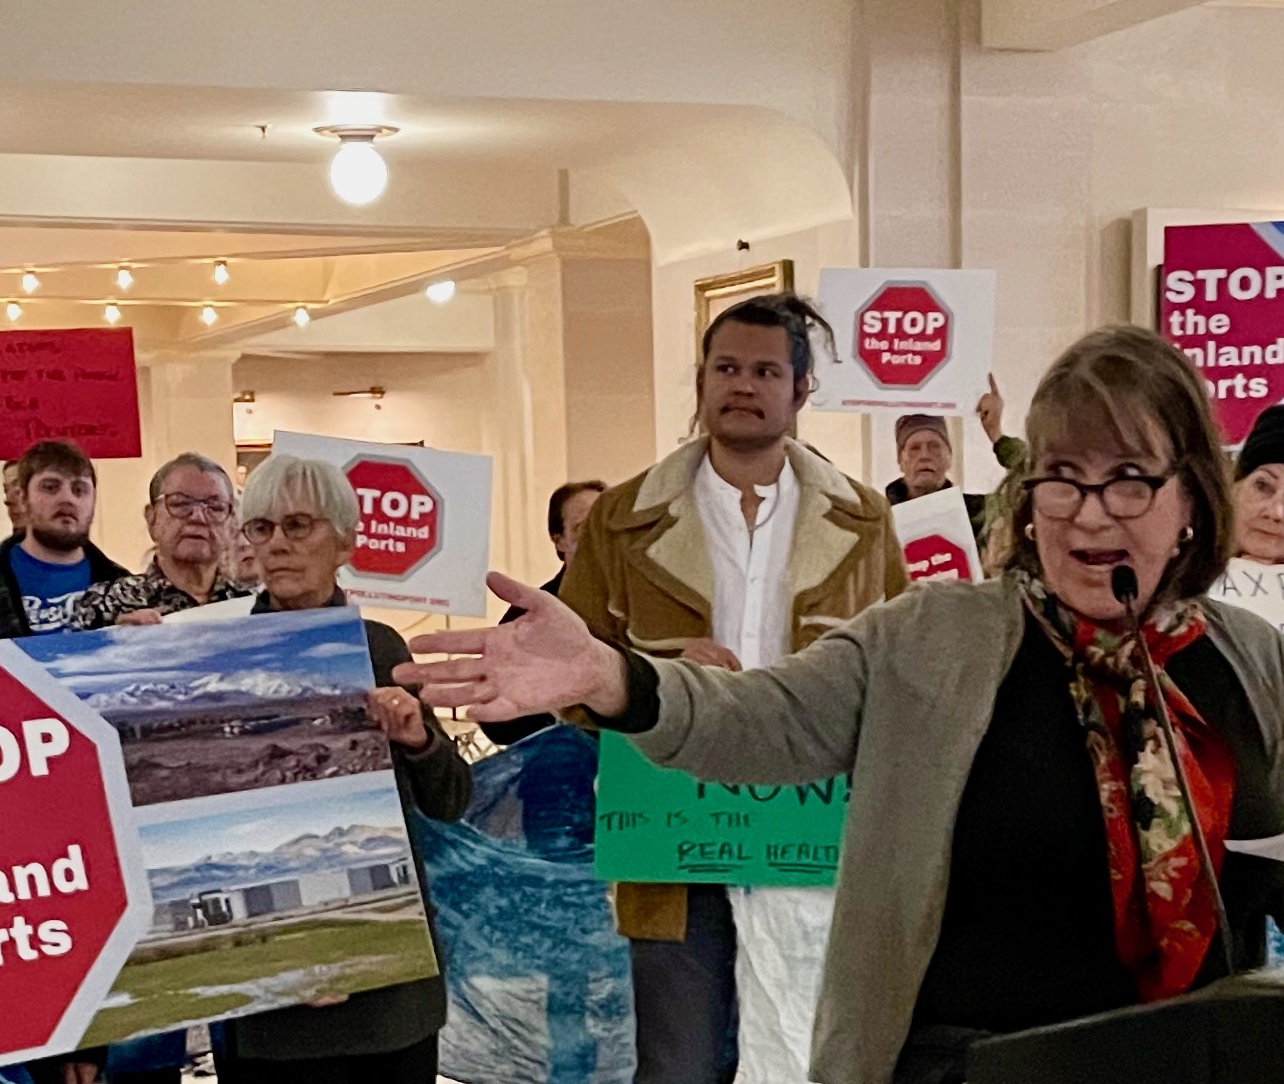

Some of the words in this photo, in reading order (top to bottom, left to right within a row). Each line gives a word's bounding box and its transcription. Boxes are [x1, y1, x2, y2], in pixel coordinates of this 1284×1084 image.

[863, 311, 945, 335] STOP
[1169, 308, 1230, 335] the
[864, 337, 889, 351] the
[894, 337, 941, 351] Inland
[881, 352, 922, 365] Ports
[357, 488, 434, 520] TOP
[370, 520, 430, 539] Inland
[355, 535, 406, 554] Ports
[667, 810, 688, 828] IS
[677, 840, 753, 862] REAL
[767, 842, 838, 862] HEALT
